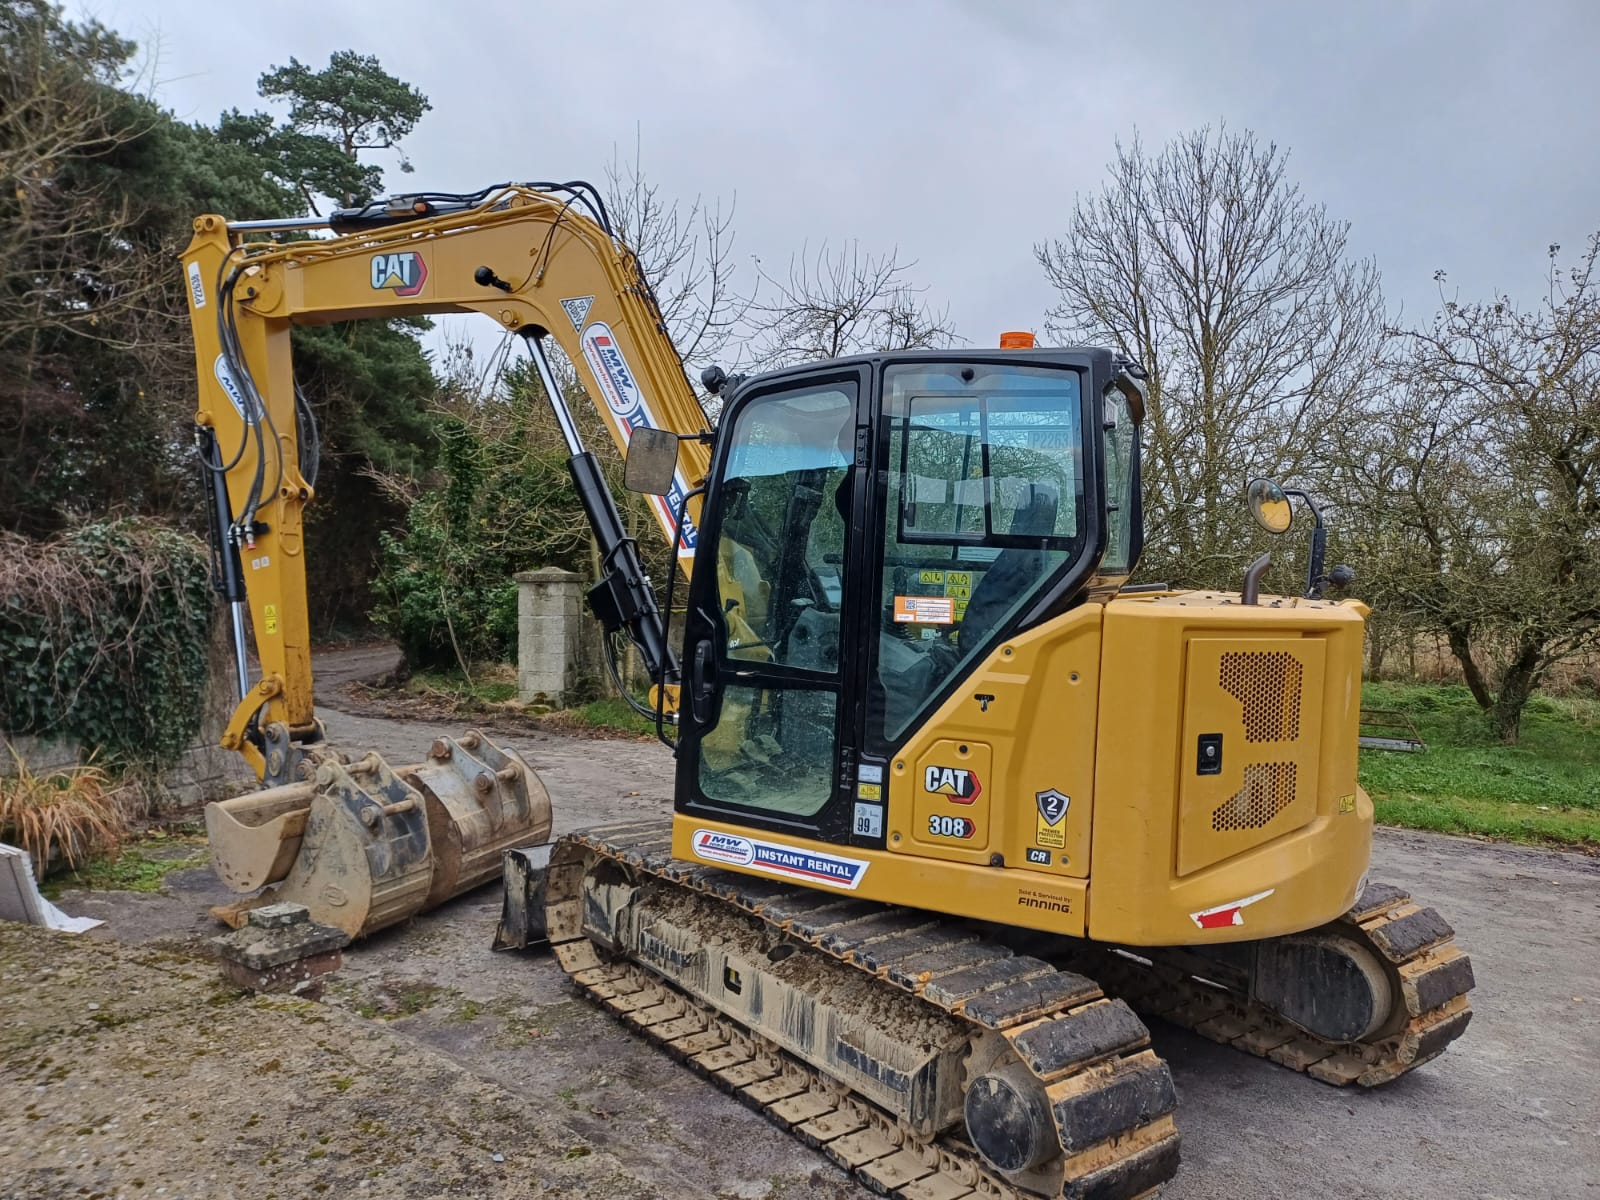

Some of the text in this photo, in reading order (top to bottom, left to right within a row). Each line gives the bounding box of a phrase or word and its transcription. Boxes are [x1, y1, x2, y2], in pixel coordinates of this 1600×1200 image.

[371, 253, 414, 289] CAT
[607, 348, 632, 389] MW
[613, 371, 630, 404] GROUP
[1031, 431, 1072, 449] P2263
[925, 766, 969, 796] CAT
[1047, 797, 1058, 812] 2
[857, 817, 870, 833] 99
[929, 815, 965, 837] 308
[711, 836, 742, 847] MW
[757, 849, 852, 877] INSTANT RENTAL
[1030, 850, 1047, 863] CR
[1018, 897, 1070, 914] FINNING
